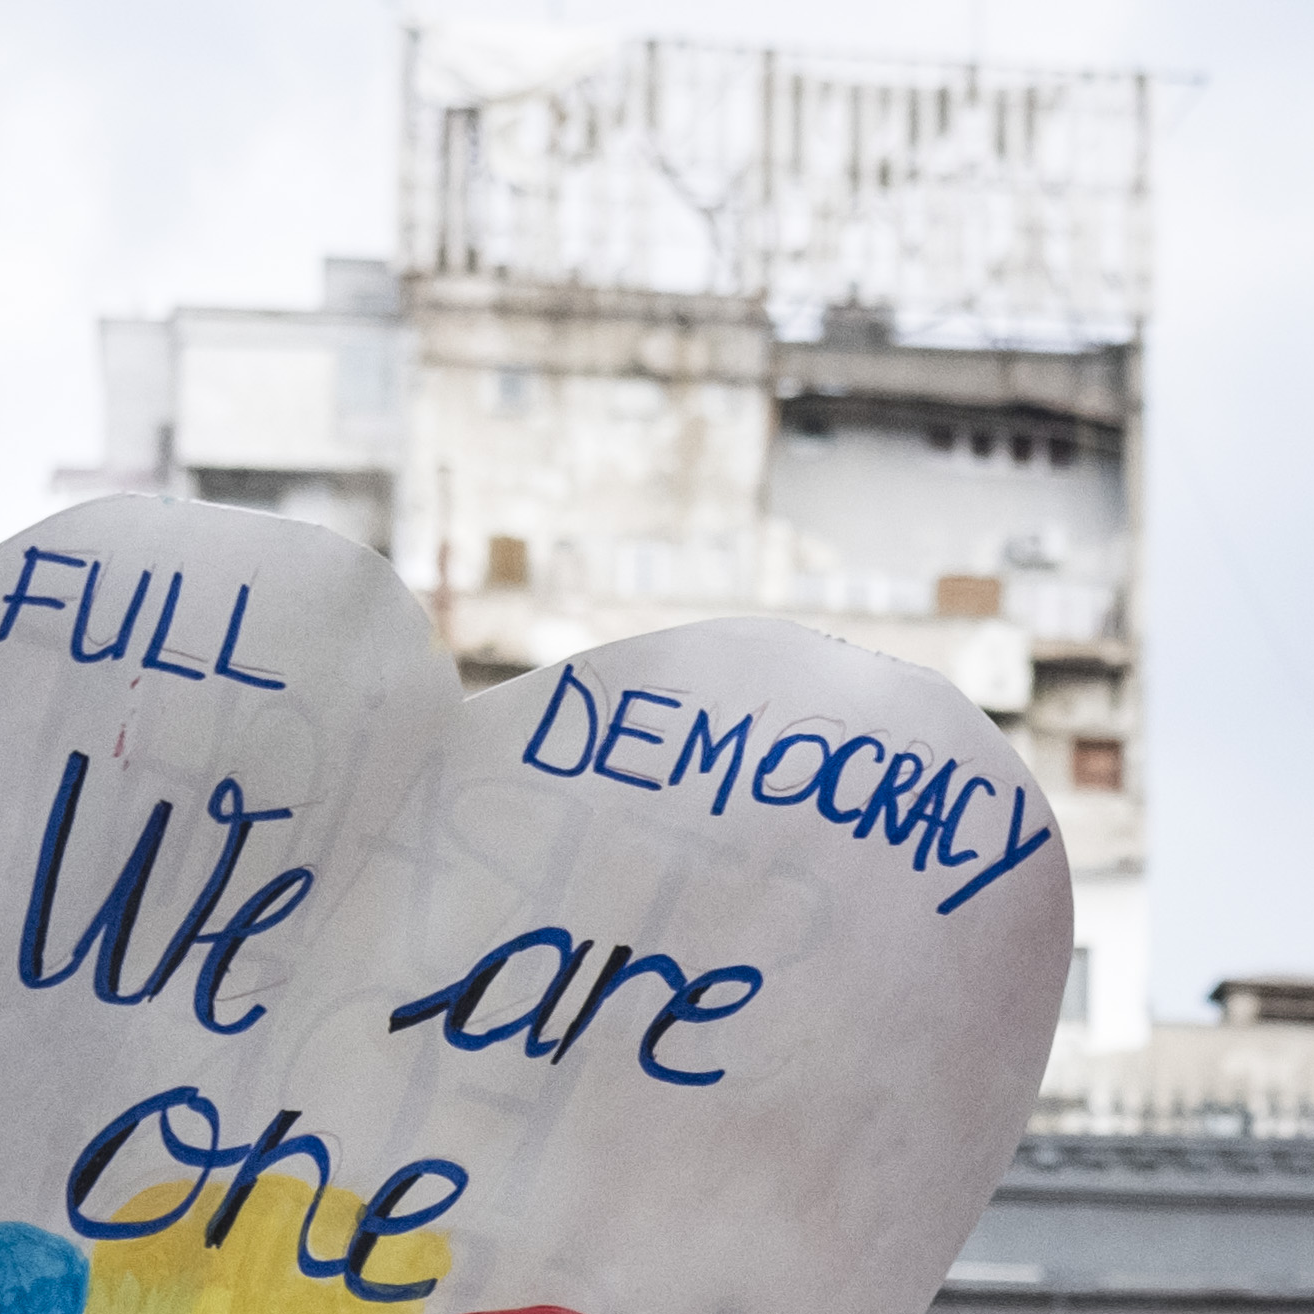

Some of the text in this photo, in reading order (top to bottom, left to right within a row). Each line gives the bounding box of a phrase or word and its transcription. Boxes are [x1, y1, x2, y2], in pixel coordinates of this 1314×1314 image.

[522, 664, 1053, 914] DEMOCRACY
[17, 750, 763, 1086] We are
[67, 1085, 469, 1303] one
